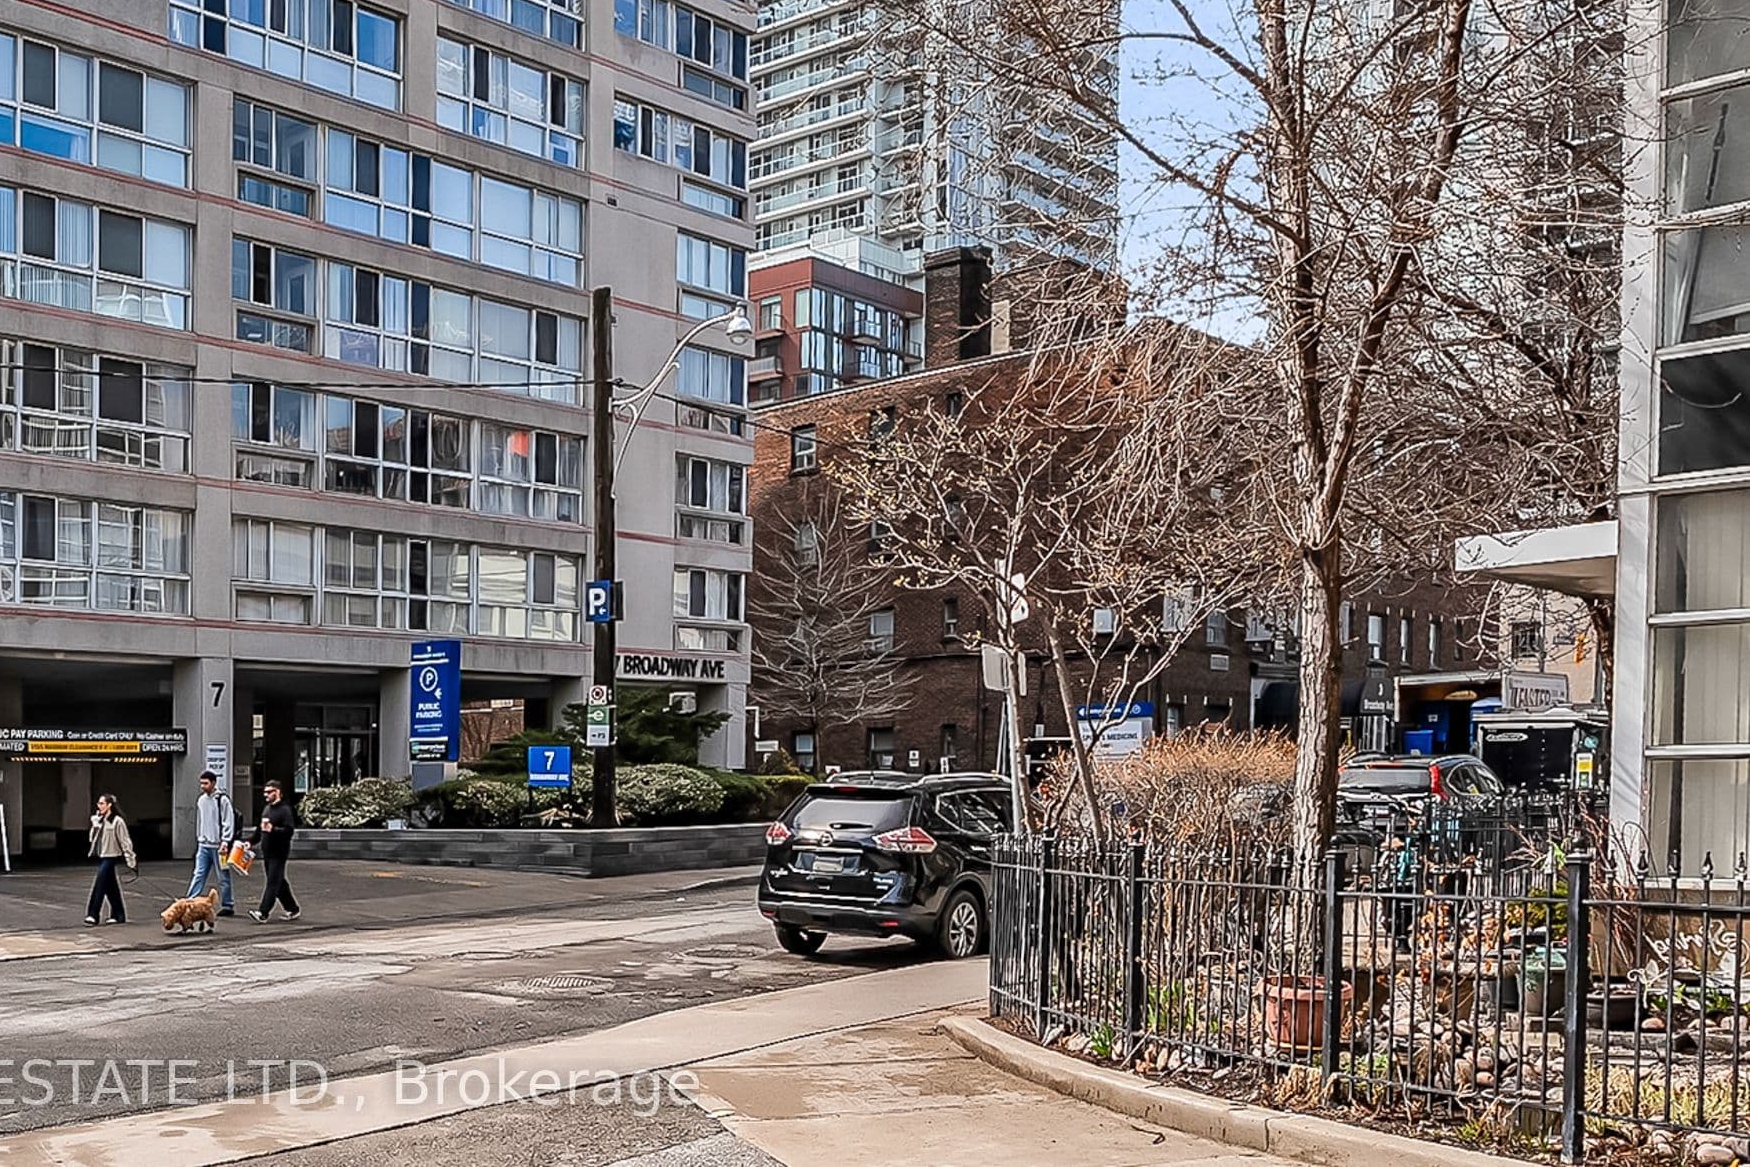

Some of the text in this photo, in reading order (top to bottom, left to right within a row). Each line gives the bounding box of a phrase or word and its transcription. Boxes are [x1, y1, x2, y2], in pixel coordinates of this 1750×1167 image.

[588, 587, 606, 616] P
[623, 654, 699, 679] BROADWAY
[699, 659, 725, 679] AVE
[426, 672, 434, 685] P
[211, 681, 226, 707] 7
[11, 728, 27, 739] PAY
[27, 729, 64, 739] PARKING
[543, 750, 555, 771] 7
